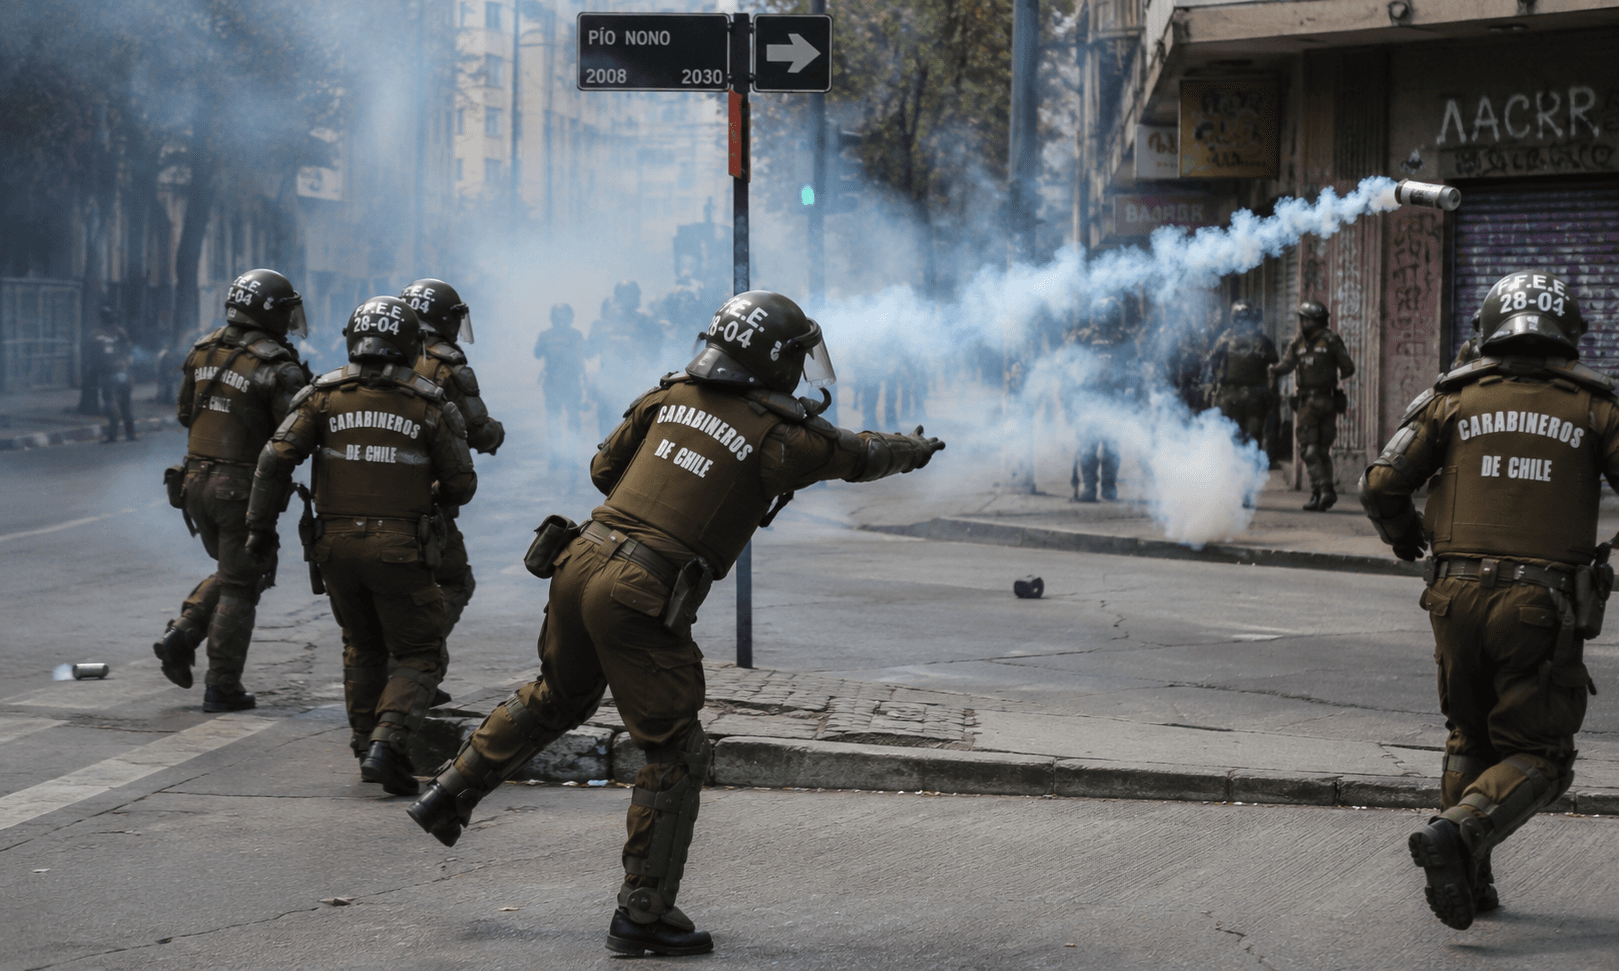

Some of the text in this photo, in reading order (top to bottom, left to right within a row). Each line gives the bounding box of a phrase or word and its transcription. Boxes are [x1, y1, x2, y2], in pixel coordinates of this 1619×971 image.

[588, 27, 671, 46] PÍO NONO
[586, 68, 723, 85] 2008 2030
[353, 315, 400, 336] 28-04
[328, 410, 421, 440] CARABINEROS
[656, 404, 754, 462] CARABINEROS
[1457, 410, 1585, 449] CARABINEROS
[346, 444, 397, 464] DE CHILE
[654, 438, 715, 479] DE CHILE
[1481, 455, 1553, 482] DE CHILE
